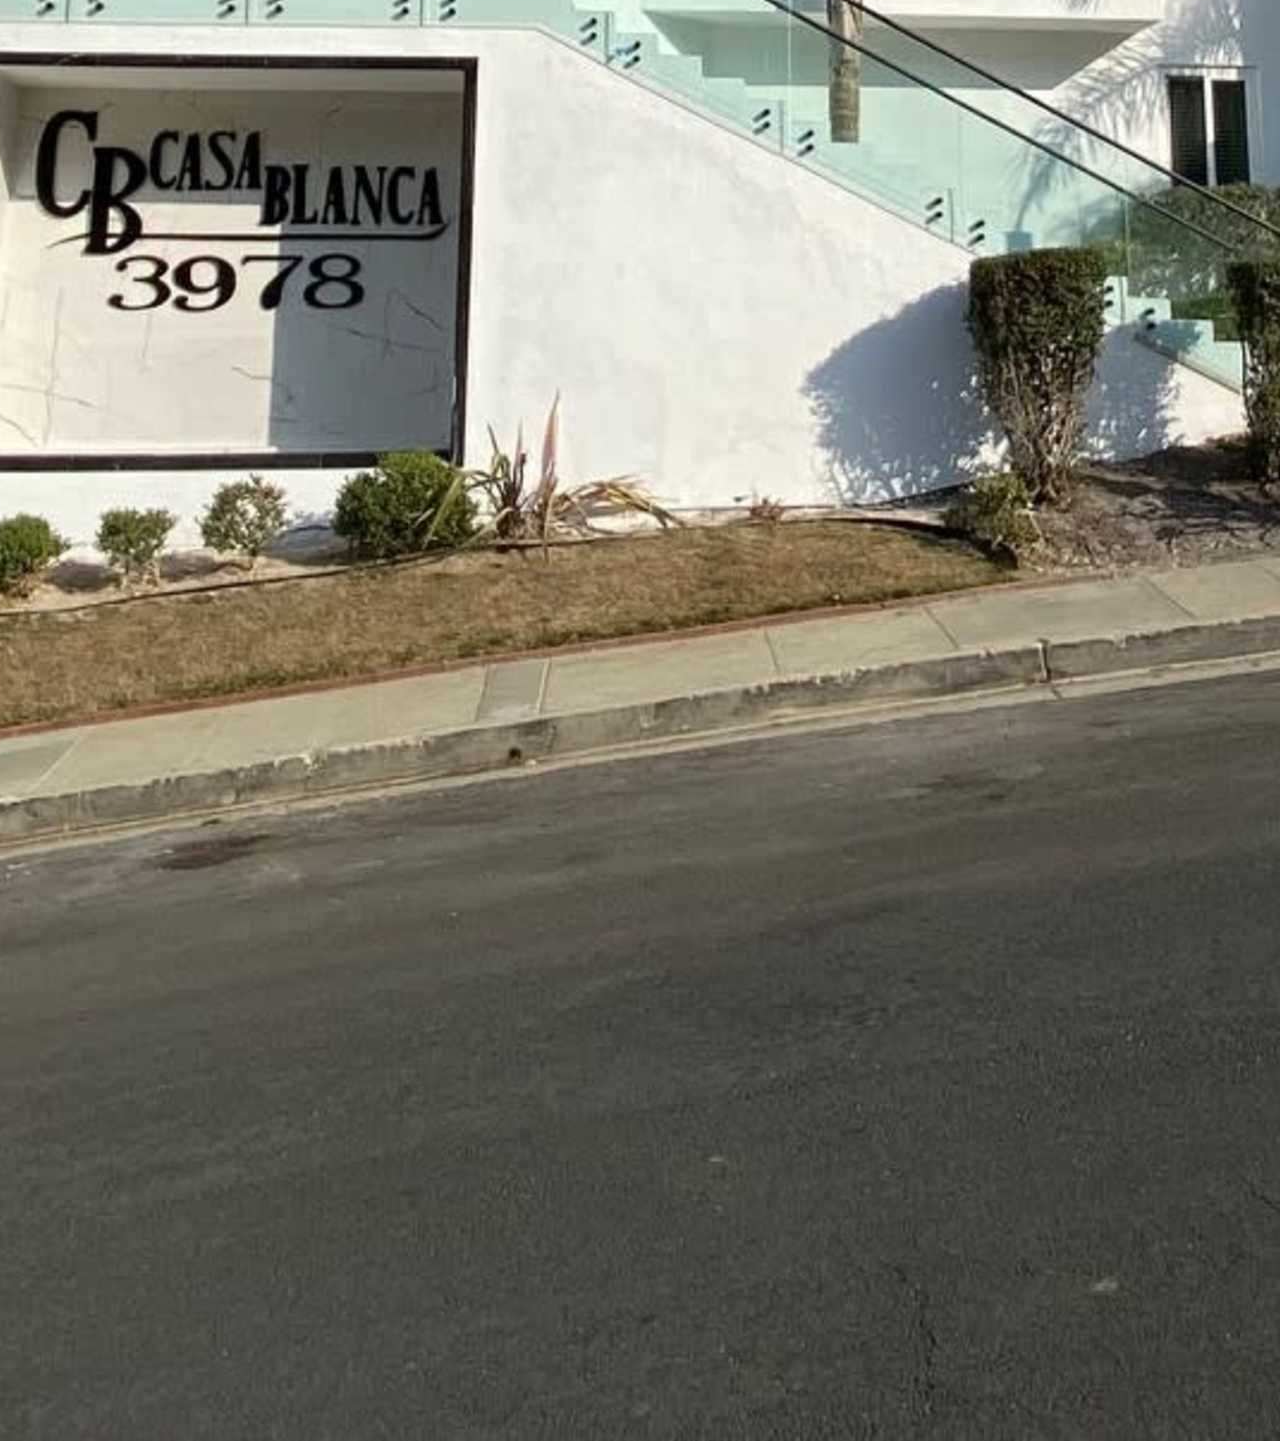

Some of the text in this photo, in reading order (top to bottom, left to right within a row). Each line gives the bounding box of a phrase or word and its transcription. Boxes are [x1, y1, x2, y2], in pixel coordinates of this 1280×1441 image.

[150, 130, 262, 191] CASA
[260, 164, 444, 226] BLANCA
[107, 255, 365, 311] 3978
